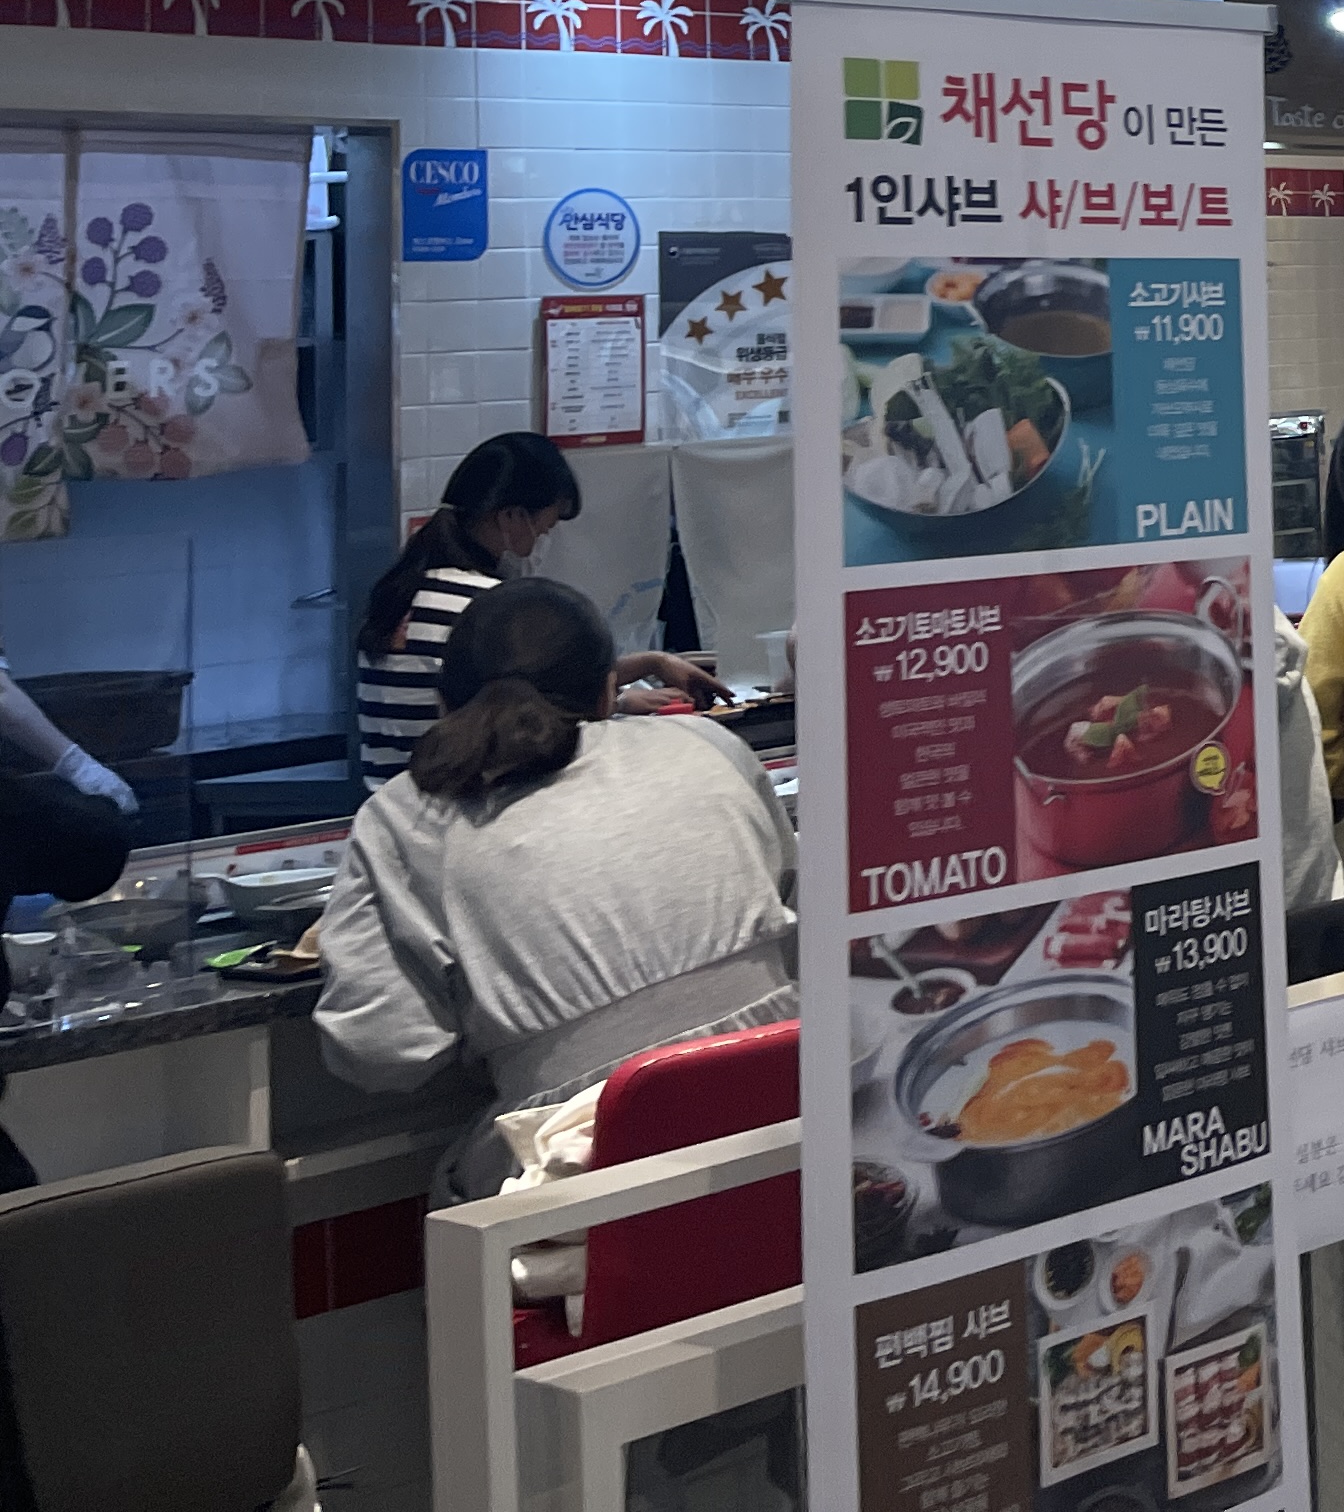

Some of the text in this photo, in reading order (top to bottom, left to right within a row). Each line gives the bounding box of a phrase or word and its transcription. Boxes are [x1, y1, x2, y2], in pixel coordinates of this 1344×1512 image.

[1165, 105, 1228, 148] 만든
[1265, 94, 1325, 129] Taste
[409, 159, 480, 185] CESCO
[559, 212, 627, 232] 안심식당
[845, 174, 1234, 232] 1인샤브 샤/브/보/트
[1127, 281, 1226, 308] 소고기샤브
[1135, 497, 1235, 539] PLAIN
[853, 604, 1004, 647] 소고기토마토샤브
[861, 846, 1007, 906] TOMATO
[1144, 888, 1253, 937] 마라탕샤브
[1142, 1106, 1226, 1159] MARA
[1180, 1121, 1269, 1179] SHABU
[874, 1298, 1014, 1370] 편백찜 샤브
